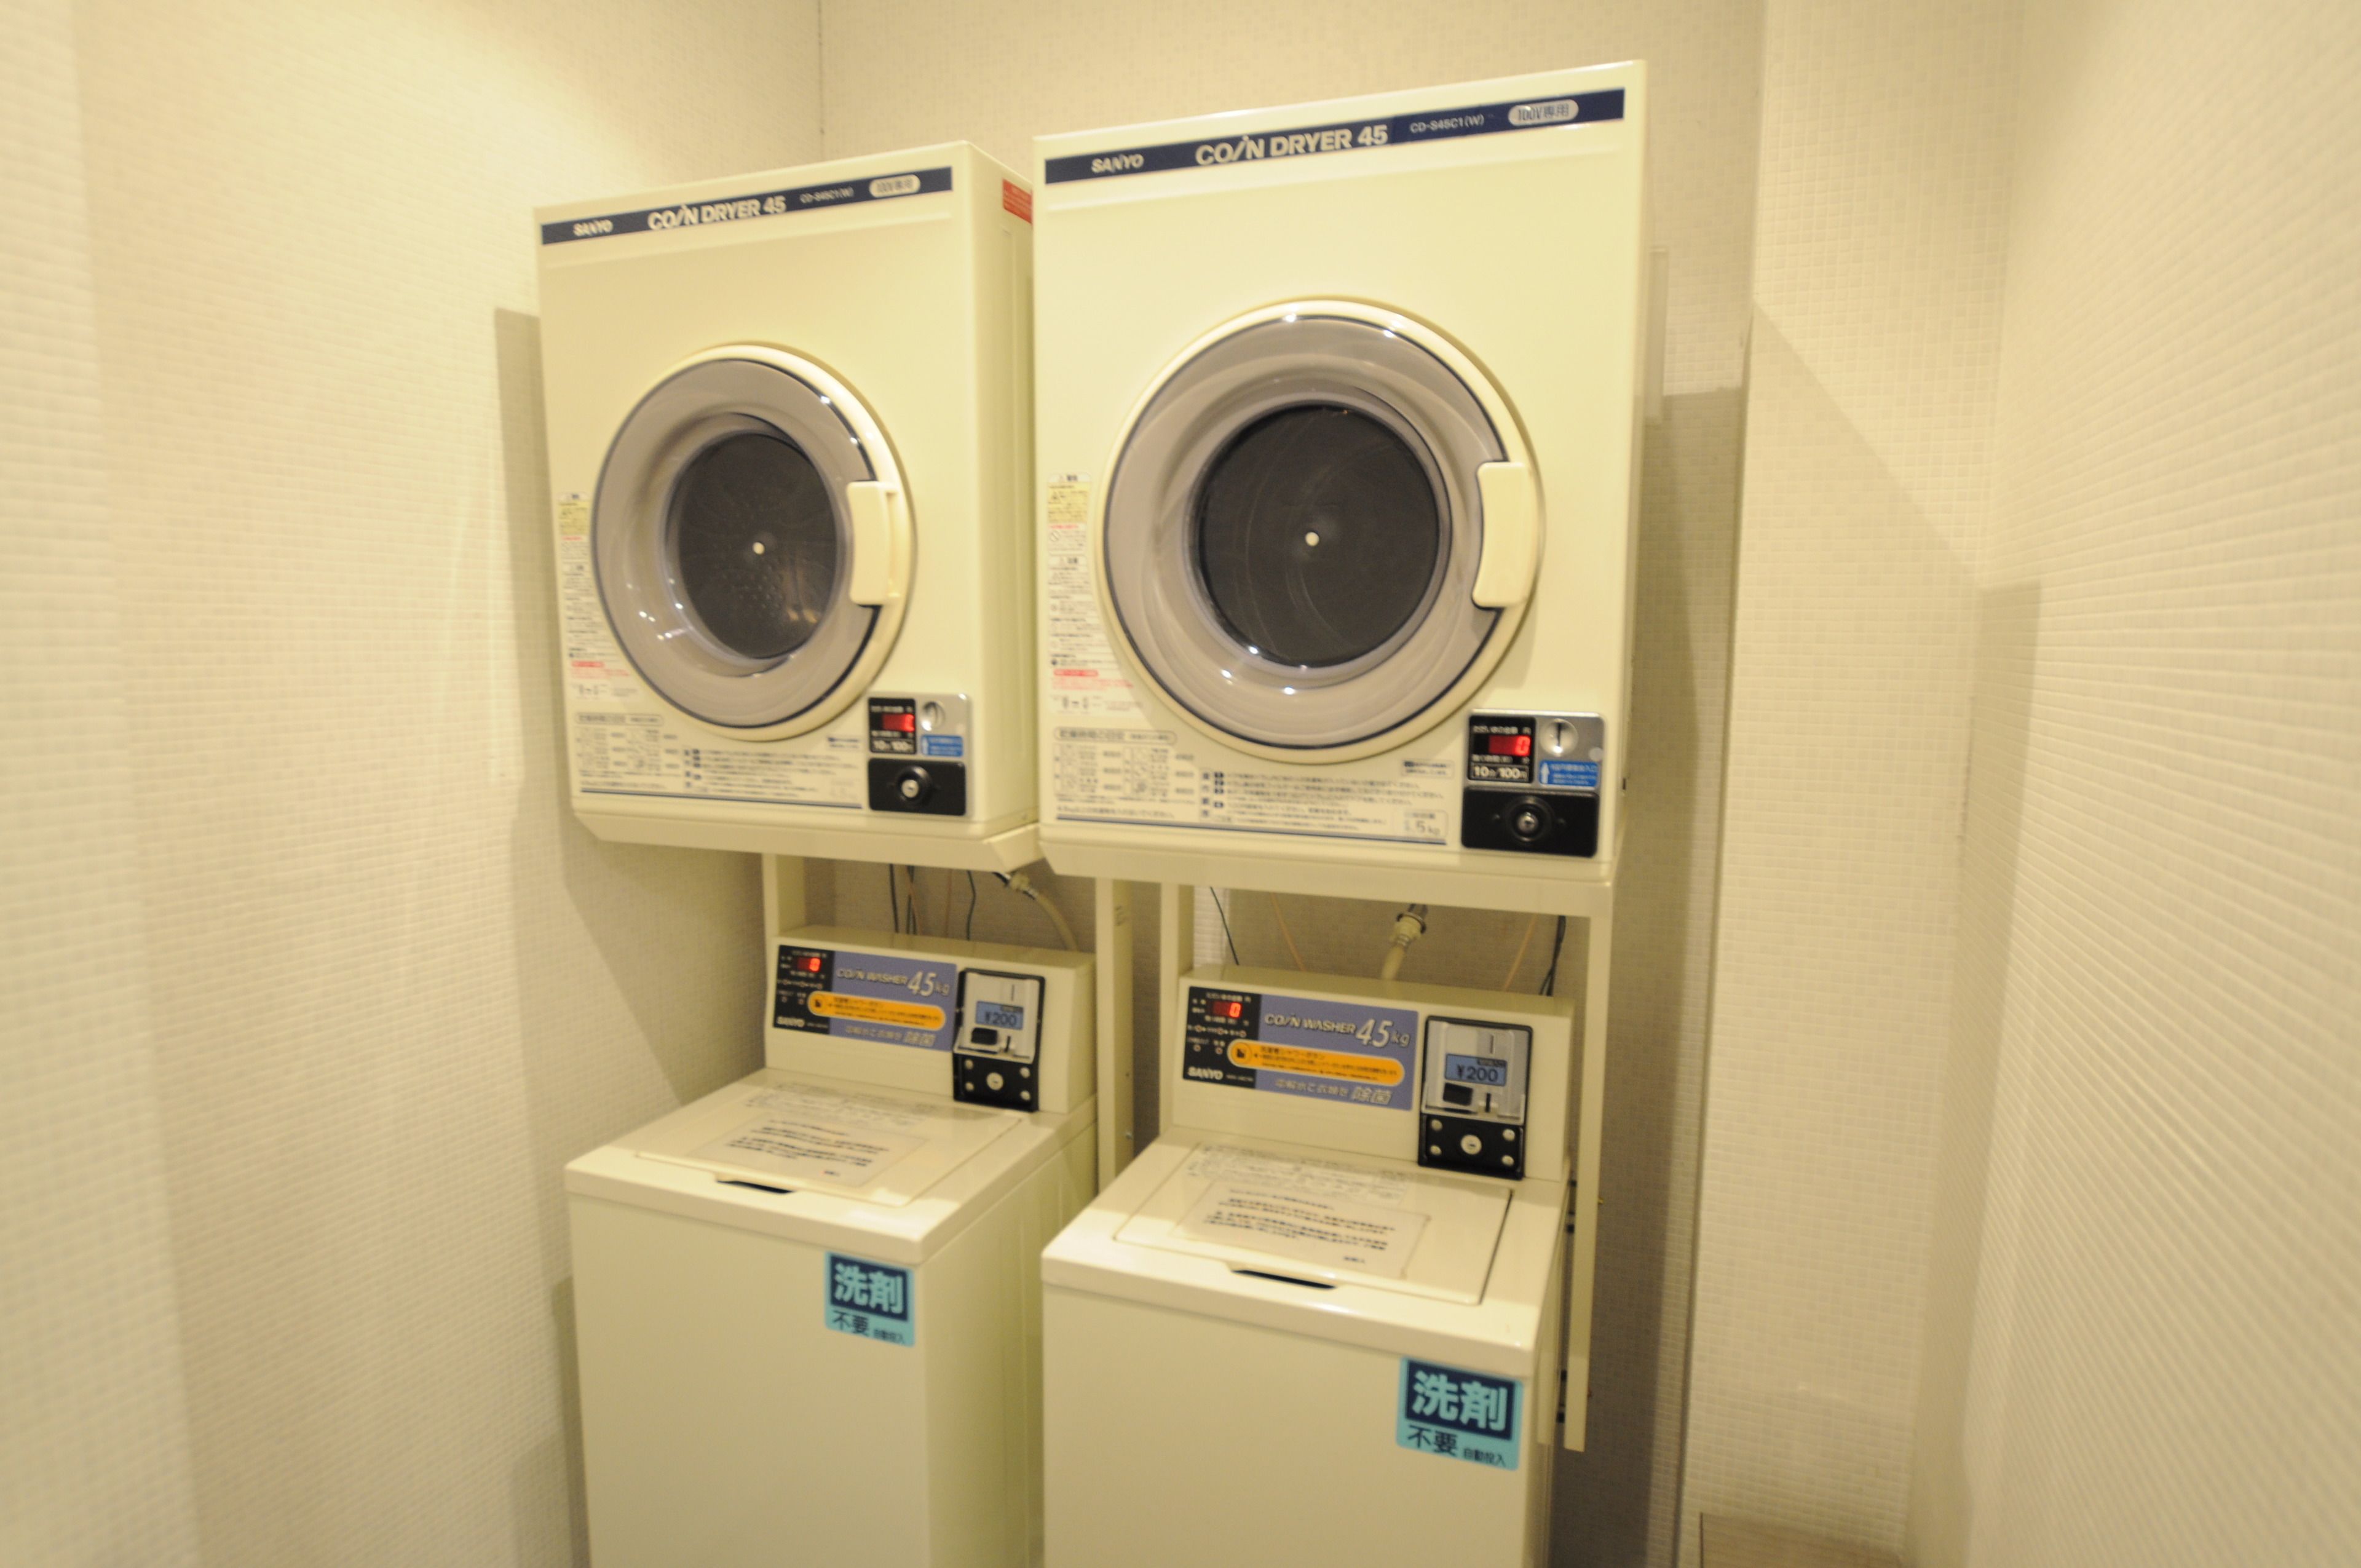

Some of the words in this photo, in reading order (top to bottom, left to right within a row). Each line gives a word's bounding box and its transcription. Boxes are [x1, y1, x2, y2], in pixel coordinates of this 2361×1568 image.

[1091, 154, 1144, 173] SANYO
[1270, 129, 1352, 157] DRYER
[1357, 124, 1388, 145] 45
[573, 219, 613, 237] SANYO
[701, 199, 761, 223] DRYER
[763, 196, 786, 214] 45
[1516, 735, 1530, 756] 0
[1230, 1002, 1242, 1018] 0
[1302, 1017, 1357, 1034] WASHER
[1188, 1066, 1224, 1080] SANYO
[1457, 1064, 1498, 1082] ¥200
[834, 1262, 903, 1314] 洗剤
[833, 1309, 869, 1337] 不要
[1412, 1370, 1508, 1431] 洗剤
[1407, 1424, 1458, 1457] 不要
[1463, 1447, 1506, 1468] 自動投入
